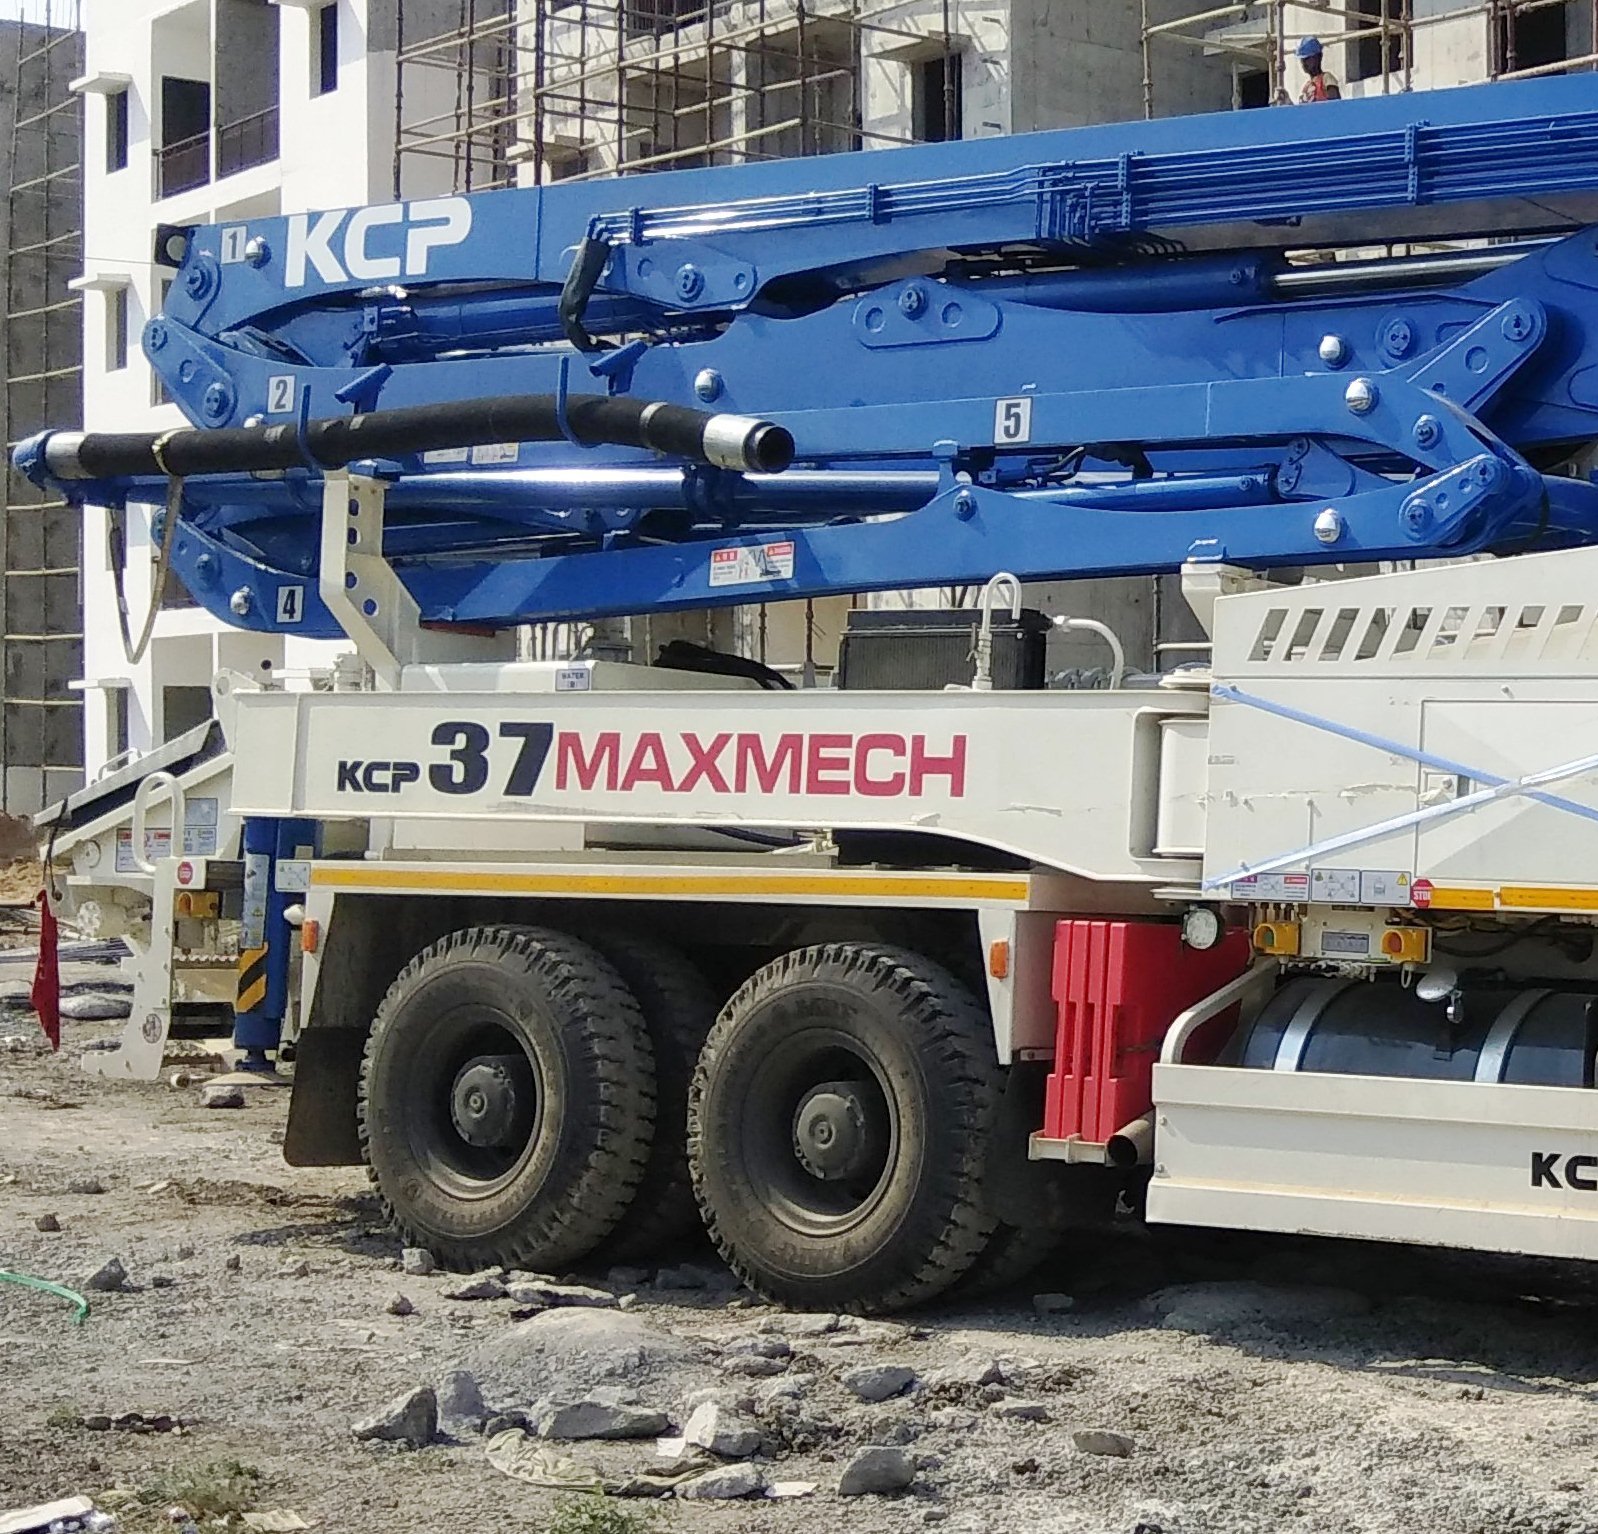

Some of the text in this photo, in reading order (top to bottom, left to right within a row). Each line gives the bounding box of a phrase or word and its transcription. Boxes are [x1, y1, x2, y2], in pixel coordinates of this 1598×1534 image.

[228, 231, 238, 260] 1
[285, 197, 472, 287] KCP
[274, 379, 287, 410] 2
[1003, 402, 1021, 439] 5
[283, 589, 296, 619] 4
[337, 760, 419, 794] KCP
